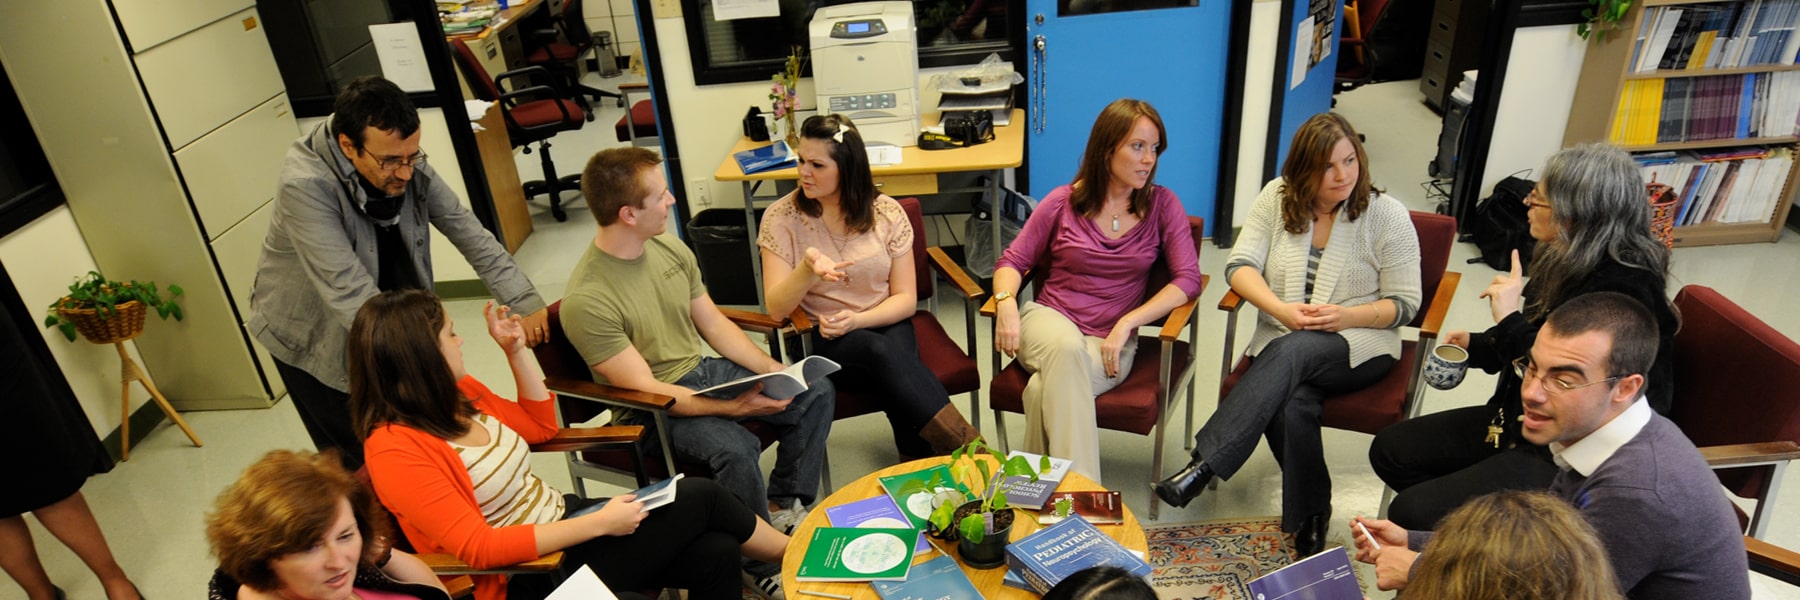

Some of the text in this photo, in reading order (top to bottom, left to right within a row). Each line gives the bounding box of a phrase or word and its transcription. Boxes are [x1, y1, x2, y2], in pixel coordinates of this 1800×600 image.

[1009, 490, 1039, 498] SCHOOL
[1033, 530, 1094, 560] PEDIATRIC
[1035, 533, 1067, 550] Handbook
